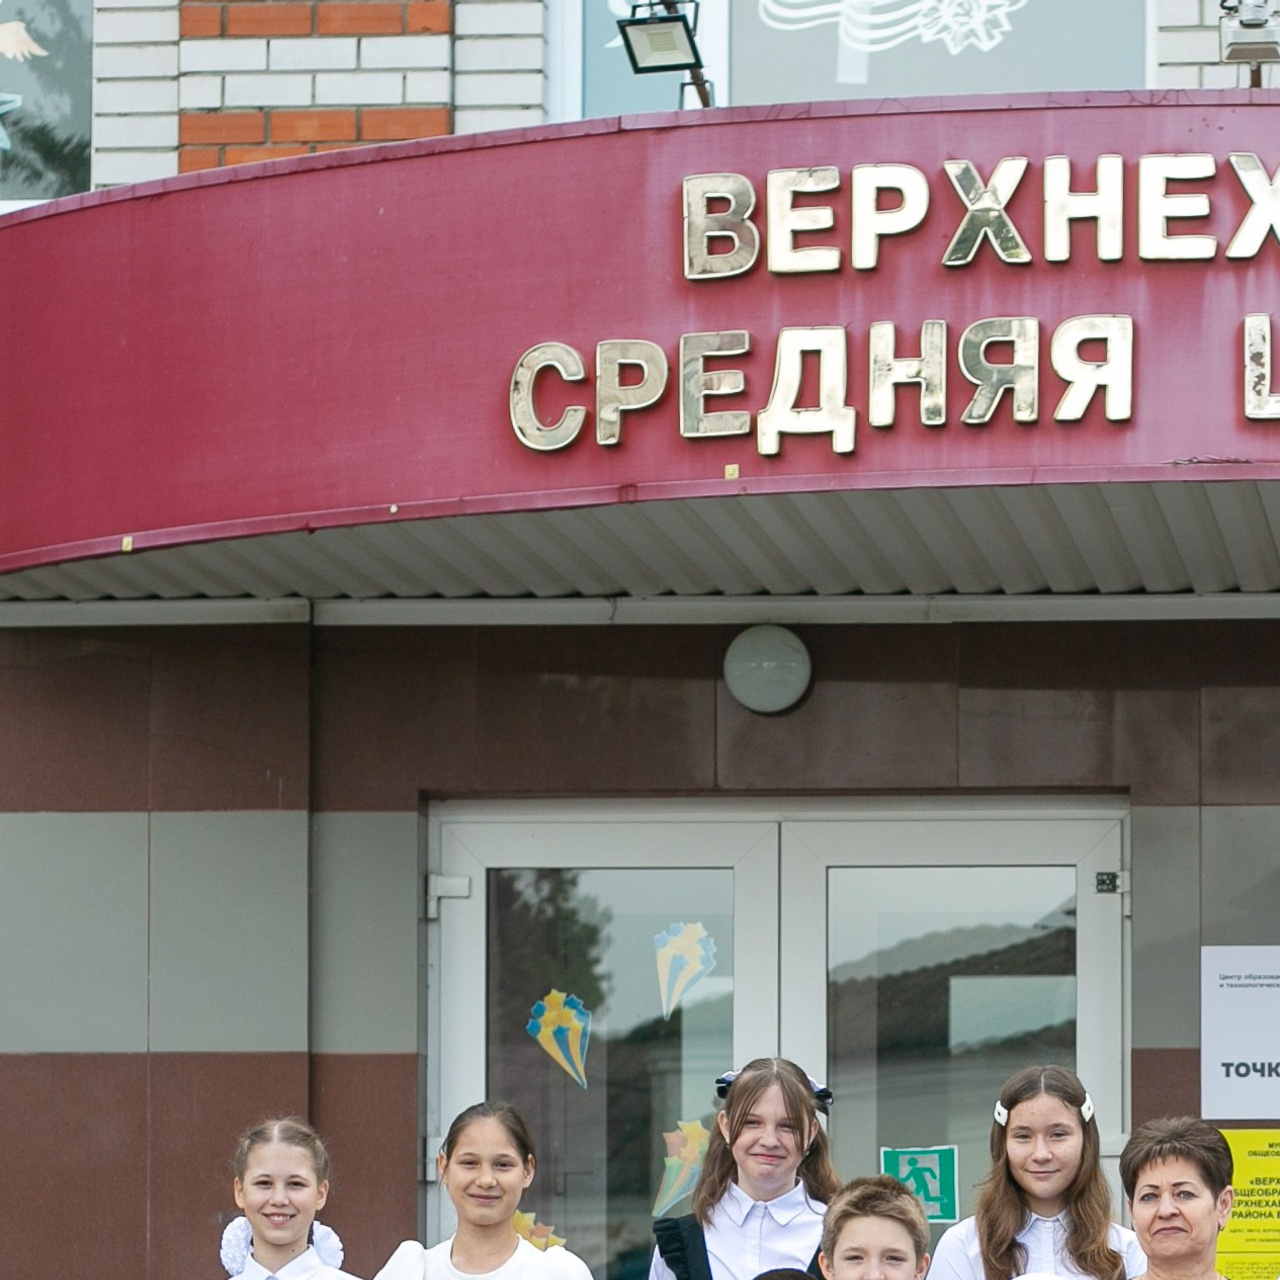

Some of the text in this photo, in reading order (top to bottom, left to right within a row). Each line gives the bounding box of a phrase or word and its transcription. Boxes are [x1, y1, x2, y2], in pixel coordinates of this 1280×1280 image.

[509, 313, 1133, 456] СРЕДНЯЯ
[1218, 972, 1242, 982] Центр
[1231, 1208, 1274, 1219] РАЙОНА
